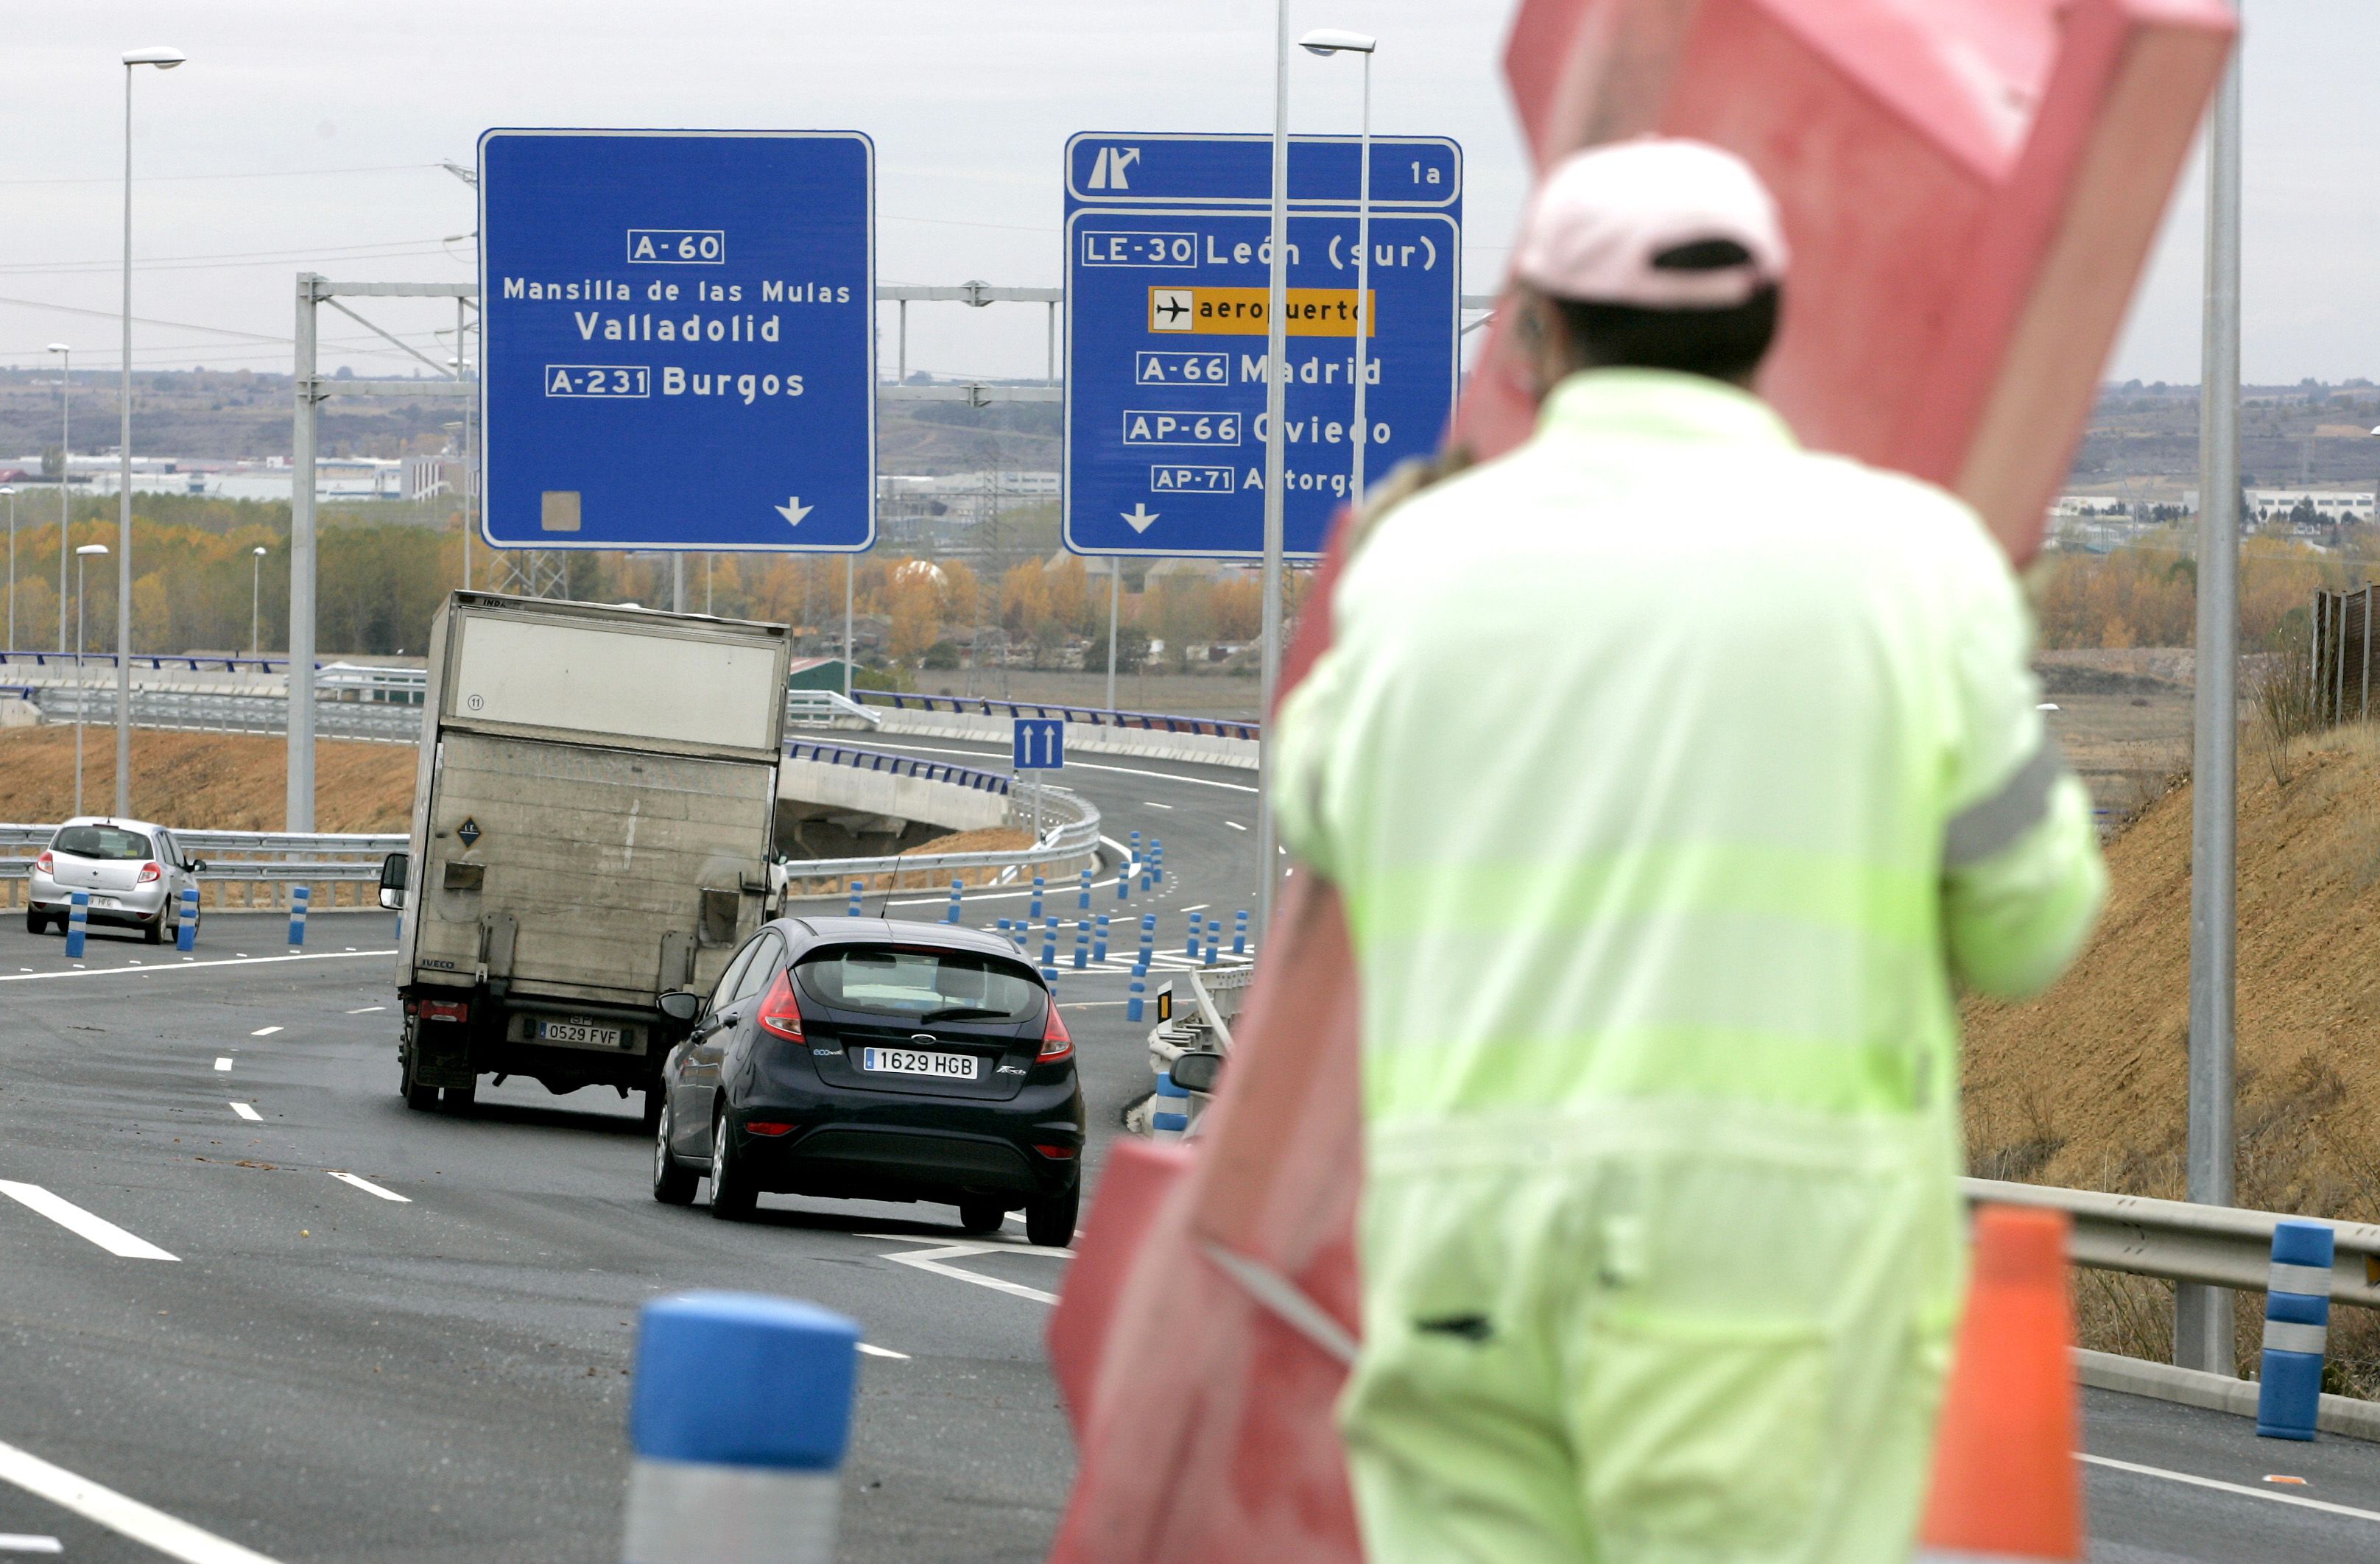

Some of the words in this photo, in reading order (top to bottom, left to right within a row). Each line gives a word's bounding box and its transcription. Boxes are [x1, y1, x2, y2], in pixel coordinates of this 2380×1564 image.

[1411, 161, 1440, 184] 1a
[634, 236, 719, 259] A-60
[1088, 238, 1191, 262] LE-30
[1207, 235, 1299, 265] León
[1329, 235, 1436, 272] (sur)
[504, 277, 630, 301] Mansilla
[647, 280, 679, 301] de
[700, 281, 742, 302] las
[762, 281, 851, 303] Mulas
[574, 311, 779, 342] Valladolid
[1142, 357, 1224, 381] A-66
[1241, 354, 1381, 385] Madrid
[551, 370, 645, 394] A-231
[663, 367, 804, 405] Burgos
[1129, 416, 1236, 442] AP-66
[1156, 472, 1231, 490] AP-71
[1242, 468, 1355, 498] Atorg
[422, 959, 455, 969] IVECO
[550, 1025, 586, 1041] 0529
[590, 1029, 616, 1044] FVF
[881, 1052, 929, 1072] 1629
[934, 1055, 973, 1076] HGB
